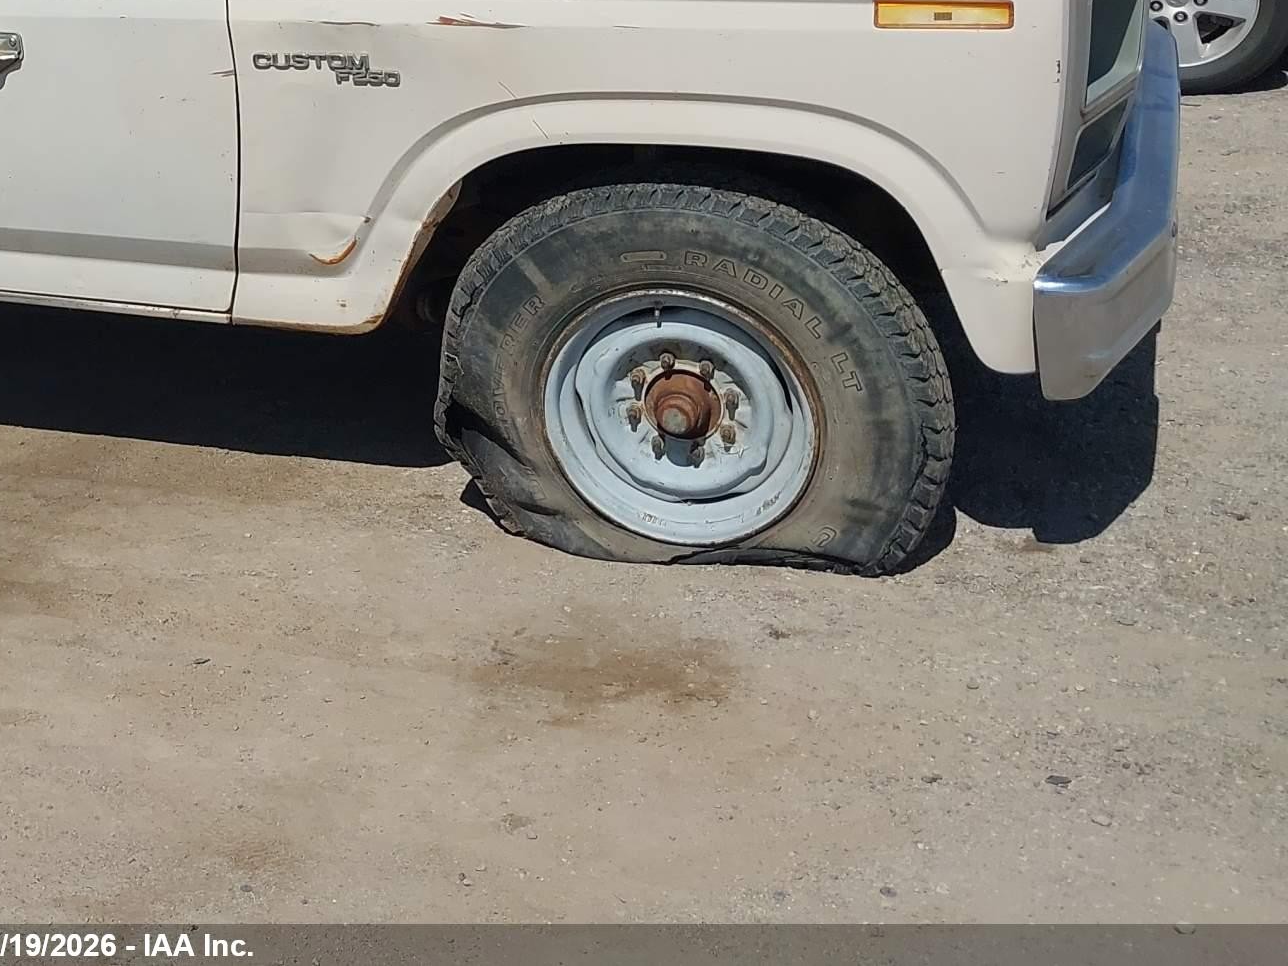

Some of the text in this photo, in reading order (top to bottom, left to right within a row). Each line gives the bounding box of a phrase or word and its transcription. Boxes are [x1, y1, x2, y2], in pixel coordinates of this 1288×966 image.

[252, 52, 371, 71] CUSTOM
[335, 69, 401, 88] F250
[683, 250, 863, 392] RADIAL LT
